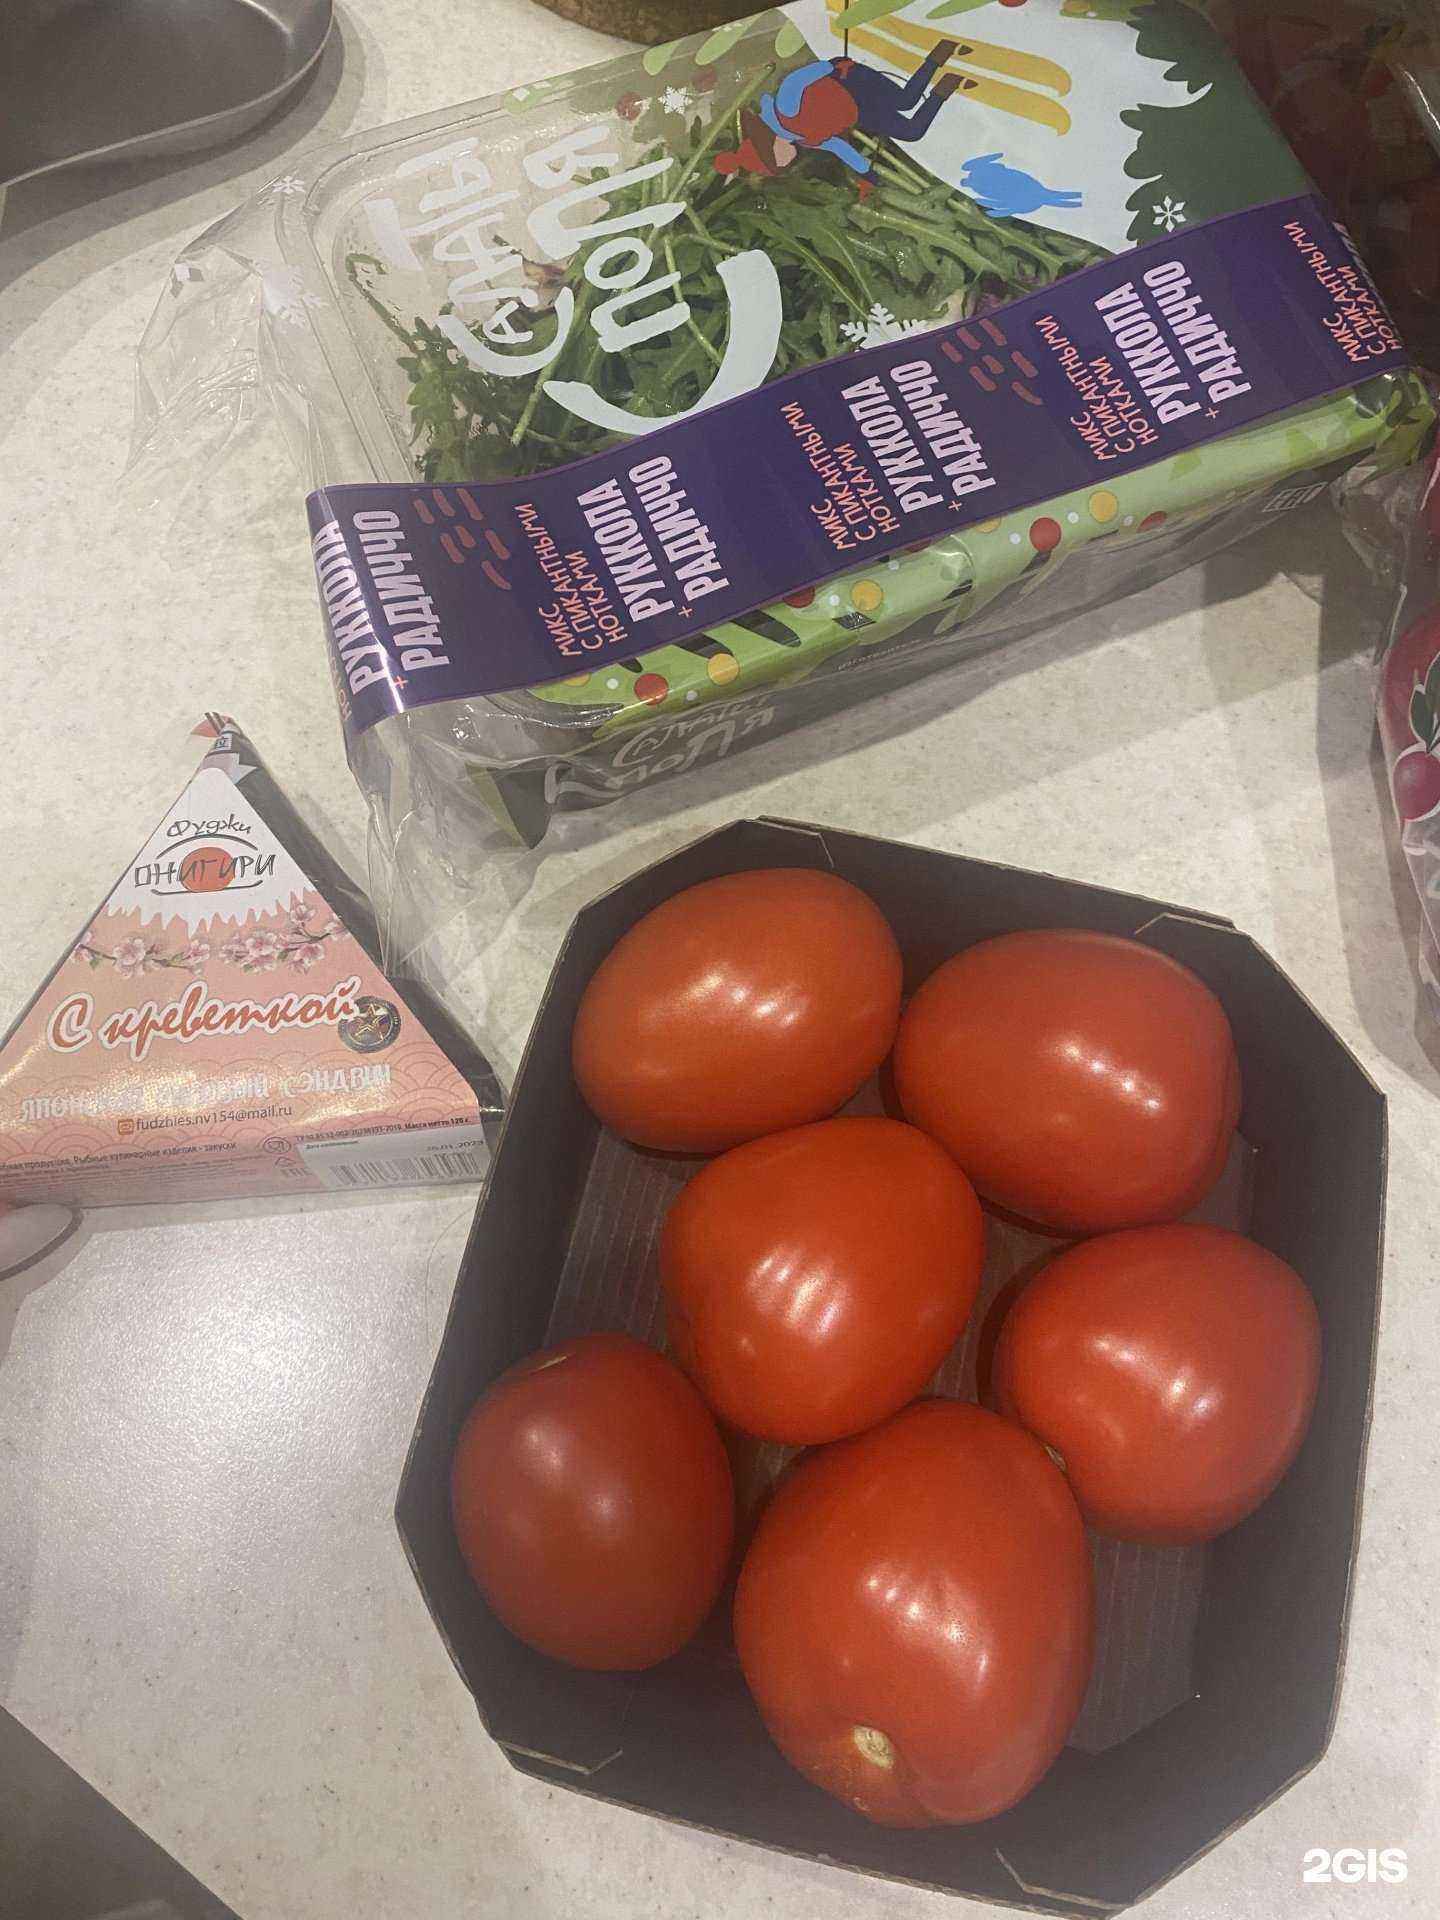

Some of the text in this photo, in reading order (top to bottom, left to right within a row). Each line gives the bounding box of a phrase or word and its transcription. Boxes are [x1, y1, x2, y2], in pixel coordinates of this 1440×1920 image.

[1282, 221, 1378, 340] ПИКАНТНЫМИ
[1337, 265, 1403, 350] НОТКАМИ
[1094, 282, 1202, 424] РУККОЛА
[1143, 260, 1252, 403] РАДИЧЧО
[1322, 313, 1370, 362] МИКС
[1366, 340, 1387, 355] С
[890, 360, 997, 497] РАДИЧЧО
[1035, 315, 1135, 453] С ПИКАНТНЫМИ
[1089, 356, 1159, 446] НОТКАМИ
[781, 402, 877, 541] С ПИКАНТНЫМИ
[841, 375, 944, 513] РУККОЛА
[1070, 411, 1117, 461] МИКС
[628, 455, 730, 602] РАДИЧЧО
[811, 498, 856, 551] МИКС
[833, 442, 900, 533] НОТКАМИ
[352, 510, 451, 672] РАДИЧЧО
[513, 503, 604, 650] С ПИКАНТНЫМИ
[564, 550, 629, 644] НОТКАМИ
[577, 478, 675, 623] РУККОЛА
[311, 519, 390, 695] РУККОЛА
[538, 602, 583, 656] МИКС
[134, 854, 277, 889] ОНИГИРИ
[166, 813, 252, 837] Фуджи
[49, 993, 93, 1053] С
[100, 977, 361, 1061] креветкой
[136, 1104, 293, 1132] fudzhies.nv154@mail.ru
